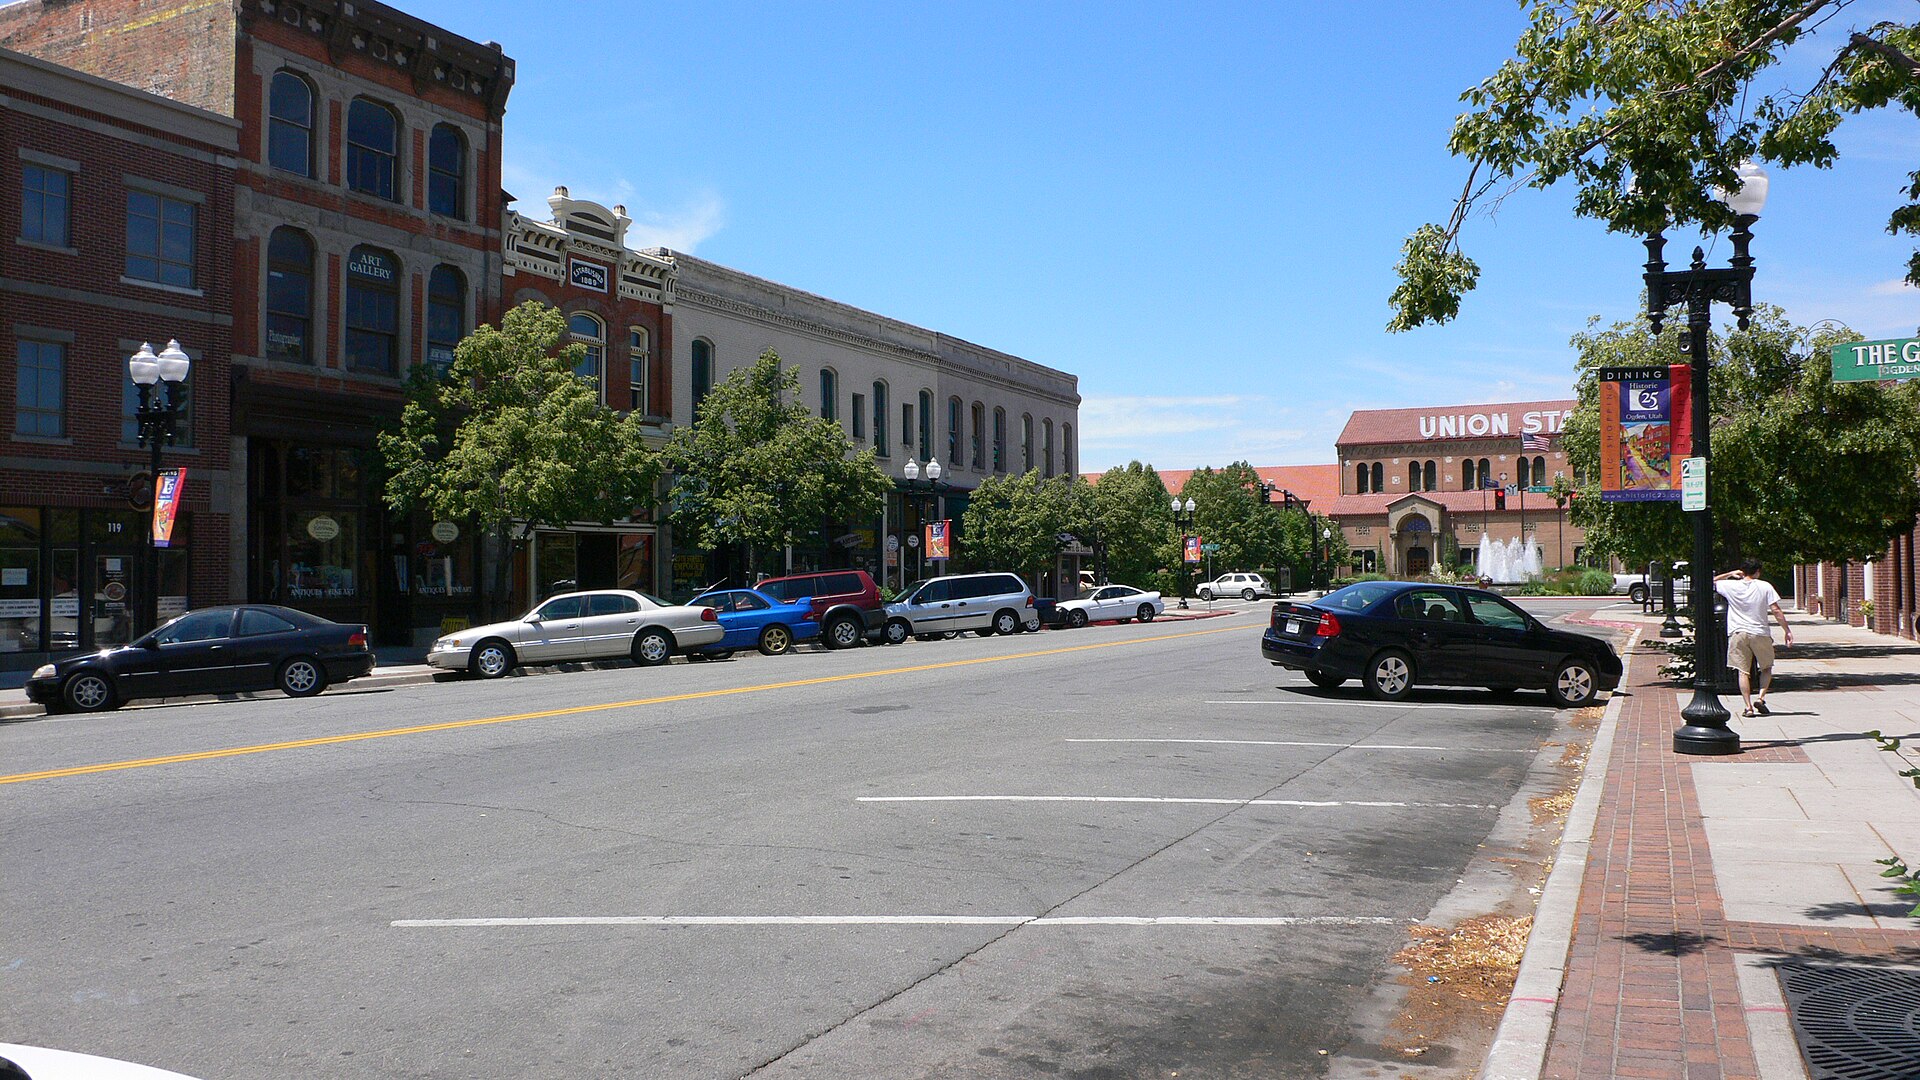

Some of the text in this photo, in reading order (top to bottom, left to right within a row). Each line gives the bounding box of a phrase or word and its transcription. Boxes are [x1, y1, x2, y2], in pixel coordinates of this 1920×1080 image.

[360, 254, 382, 267] ART
[350, 261, 391, 279] GALLERY
[573, 266, 603, 284] ESTABLISHED
[1851, 341, 1920, 366] THE G
[1607, 370, 1662, 380] DINING
[1641, 391, 1659, 408] 25
[1626, 413, 1648, 421] Ogden,
[1677, 370, 1686, 449] NIGHTLIFE
[1419, 412, 1509, 438] UNION
[1682, 461, 1690, 477] 2
[108, 523, 122, 533] 119
[290, 588, 323, 597] ANTIQUES
[343, 588, 355, 596] ART
[418, 586, 445, 595] ANTIQUES
